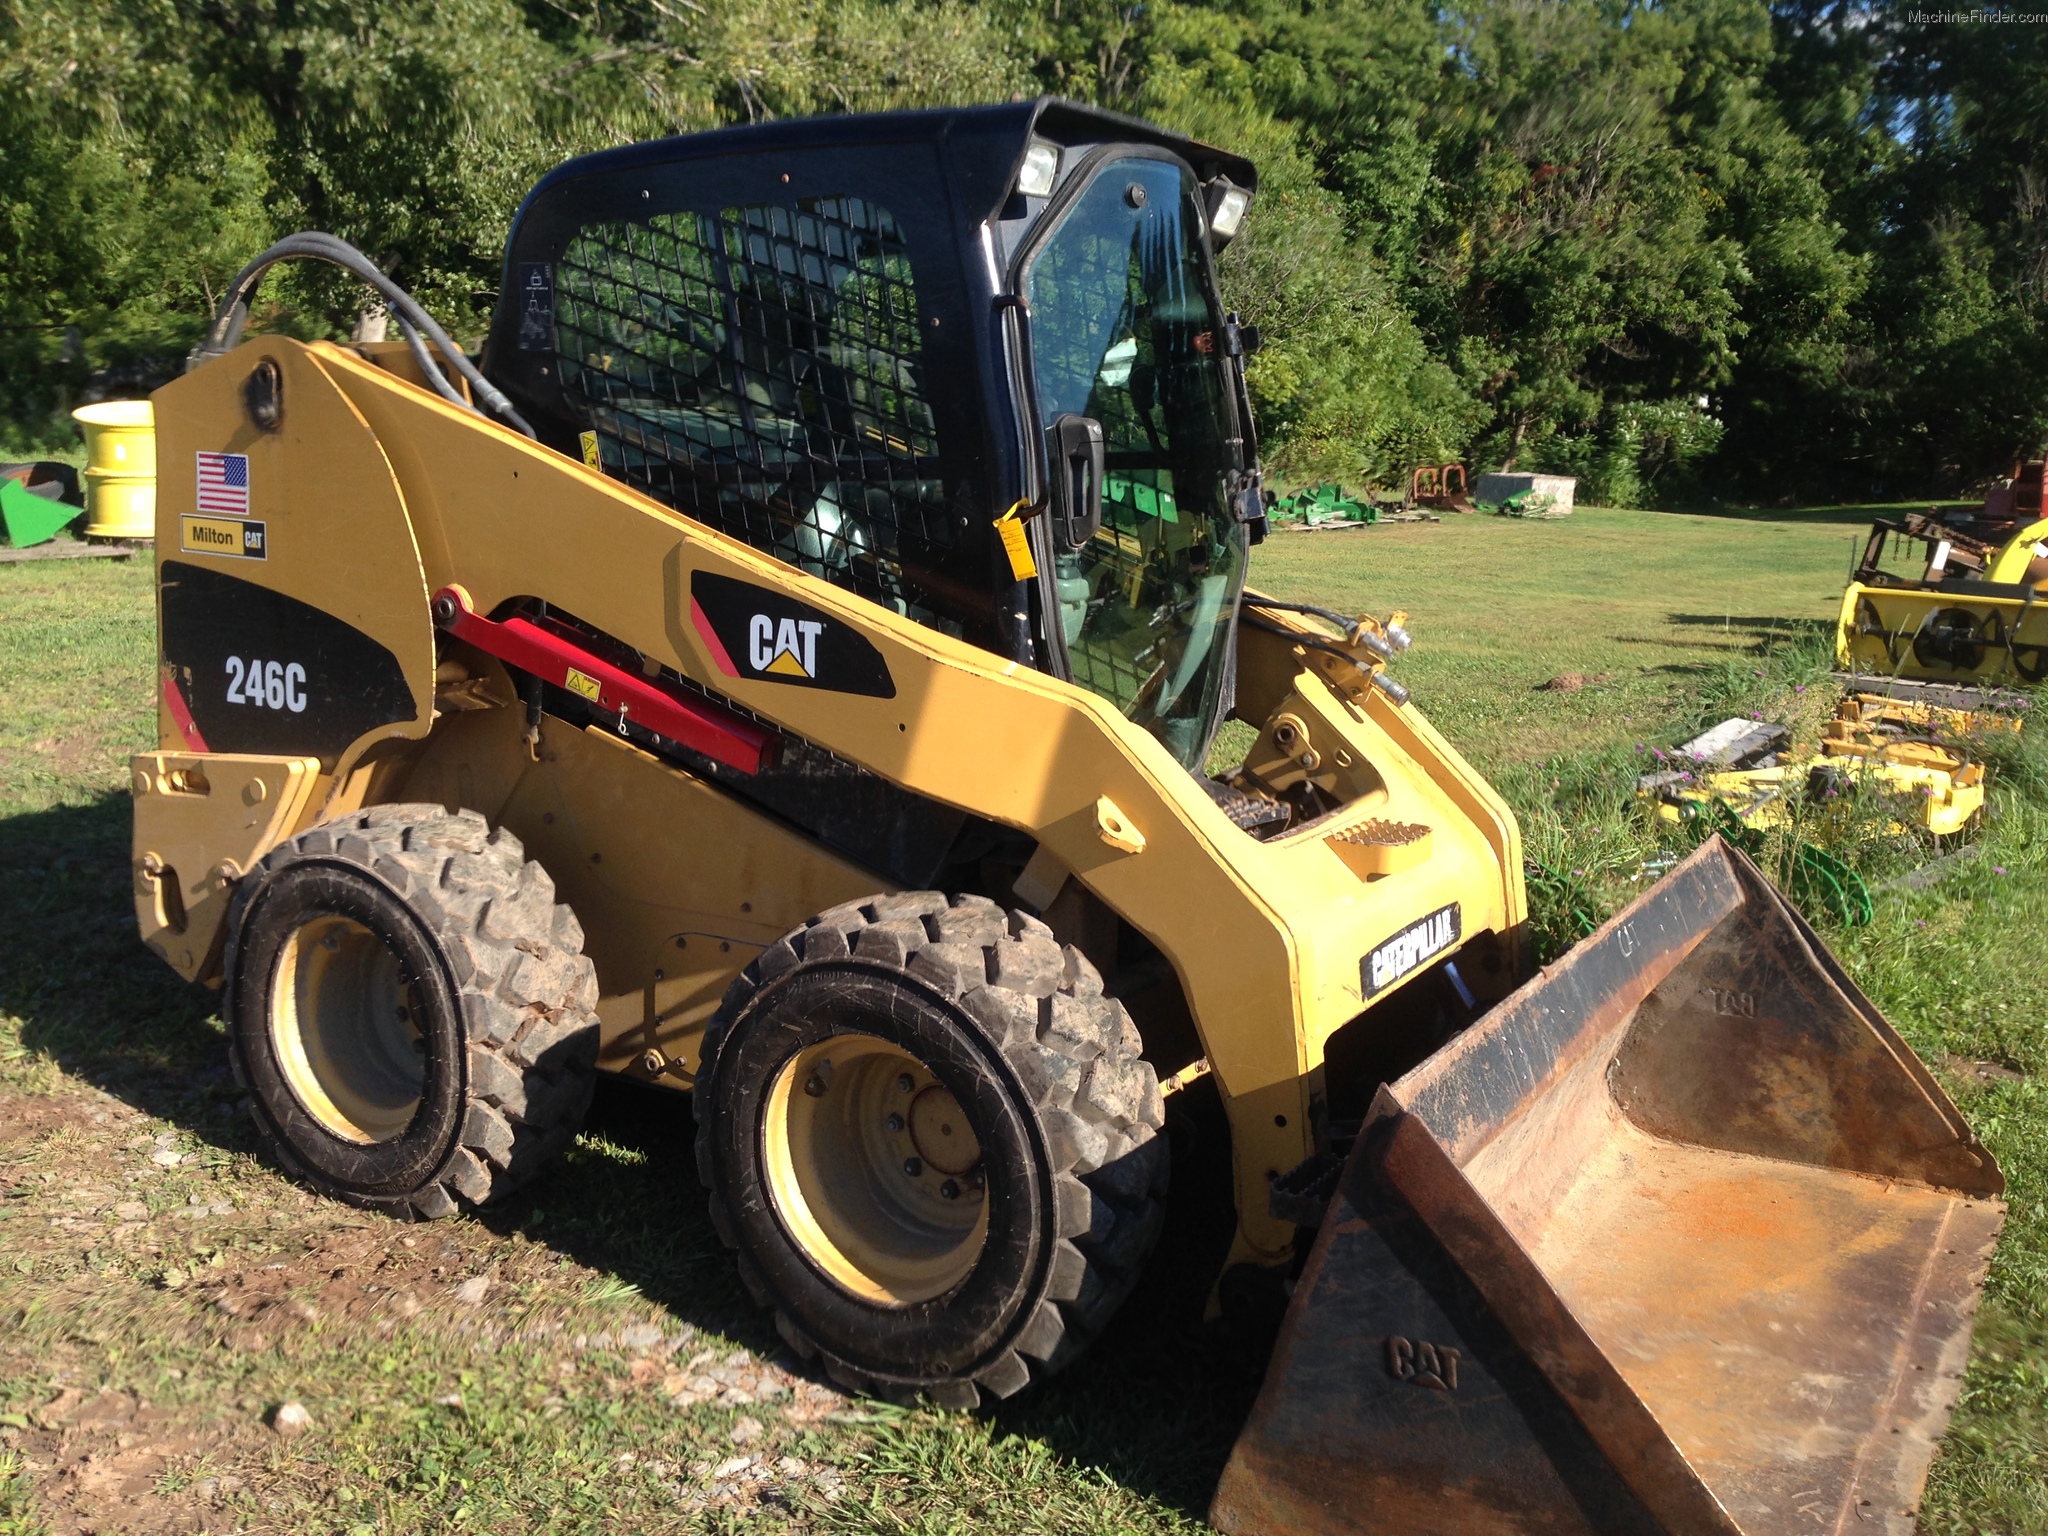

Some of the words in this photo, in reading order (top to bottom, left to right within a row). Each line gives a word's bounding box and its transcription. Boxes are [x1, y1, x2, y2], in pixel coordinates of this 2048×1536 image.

[192, 526, 234, 546] Milton
[244, 530, 264, 549] CAT
[749, 613, 822, 679] CAT
[225, 655, 307, 713] 246C
[1371, 907, 1455, 990] CATERPILLAR
[1388, 1335, 1462, 1391] CAT
